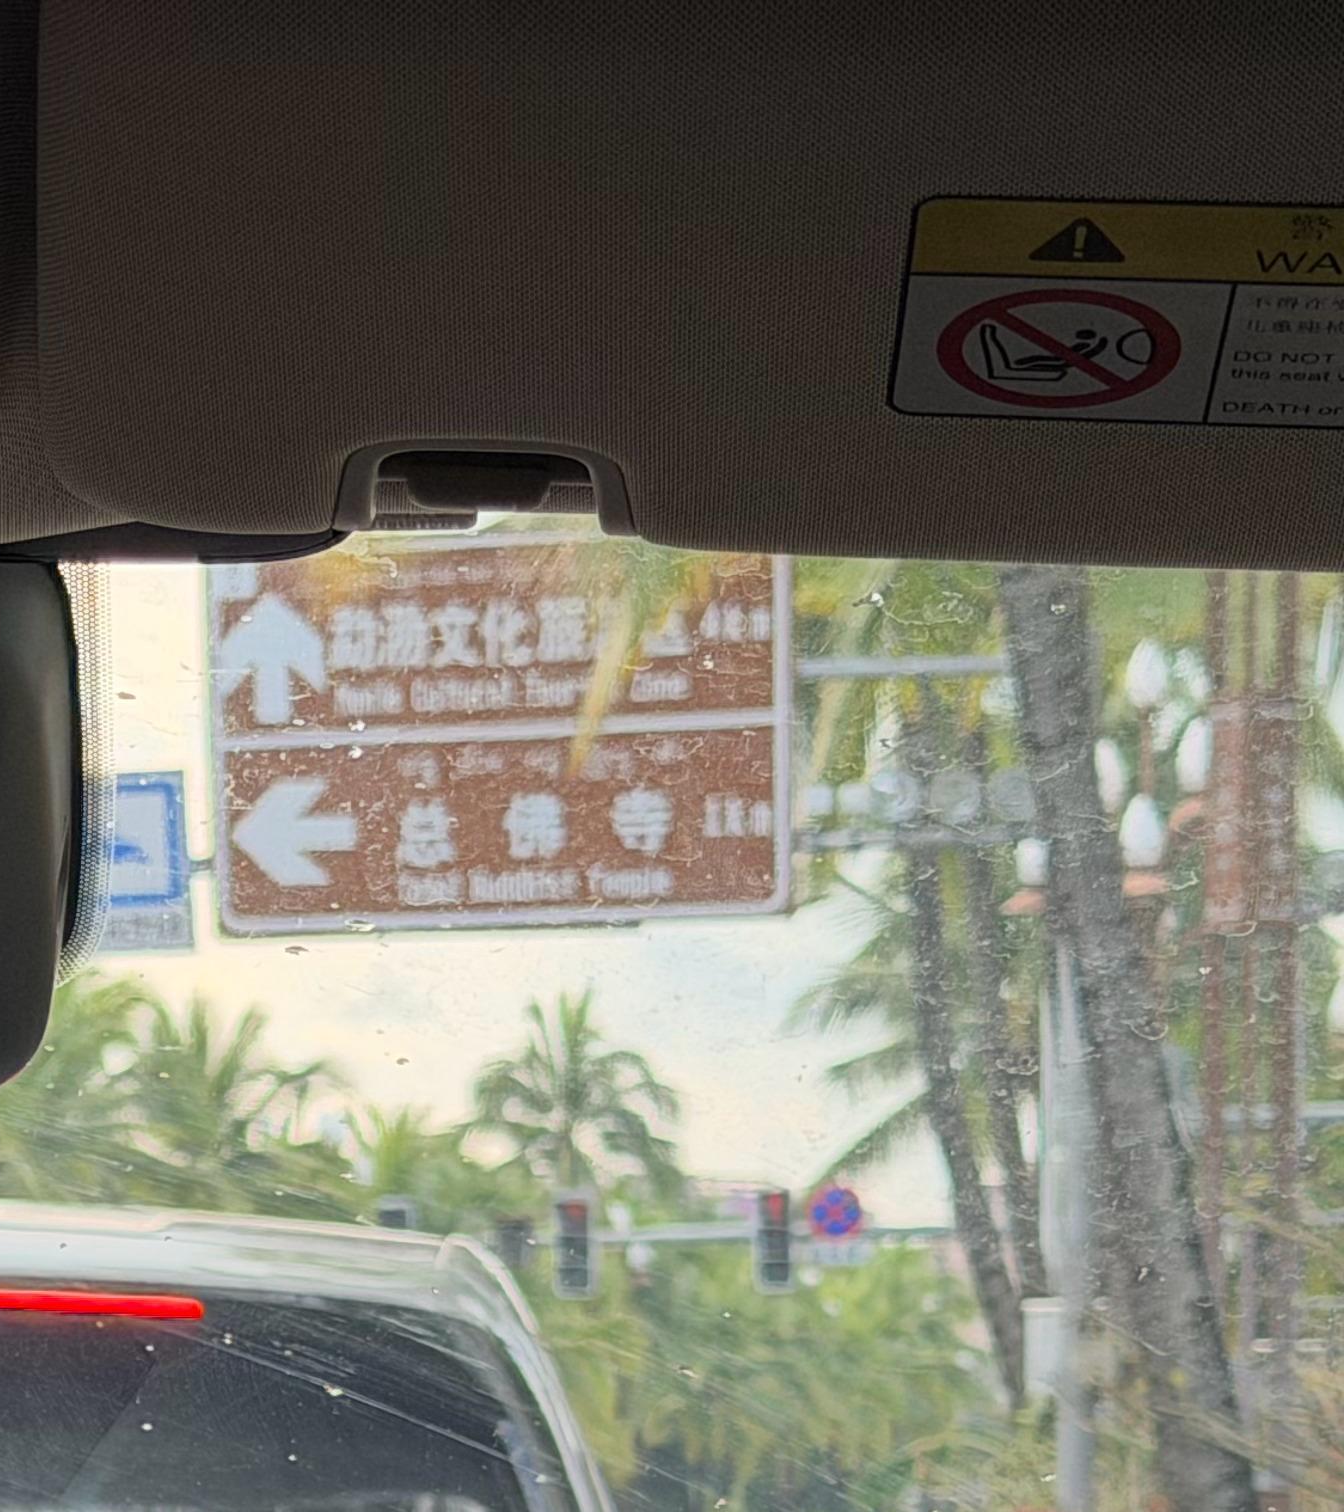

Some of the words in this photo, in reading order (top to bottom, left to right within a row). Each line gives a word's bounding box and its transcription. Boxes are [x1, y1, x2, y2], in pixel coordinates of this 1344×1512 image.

[1233, 350, 1272, 363] DO
[1280, 352, 1336, 365] NOT
[1231, 367, 1271, 380] this
[1279, 369, 1331, 382] seat
[1222, 401, 1311, 415] DEATH
